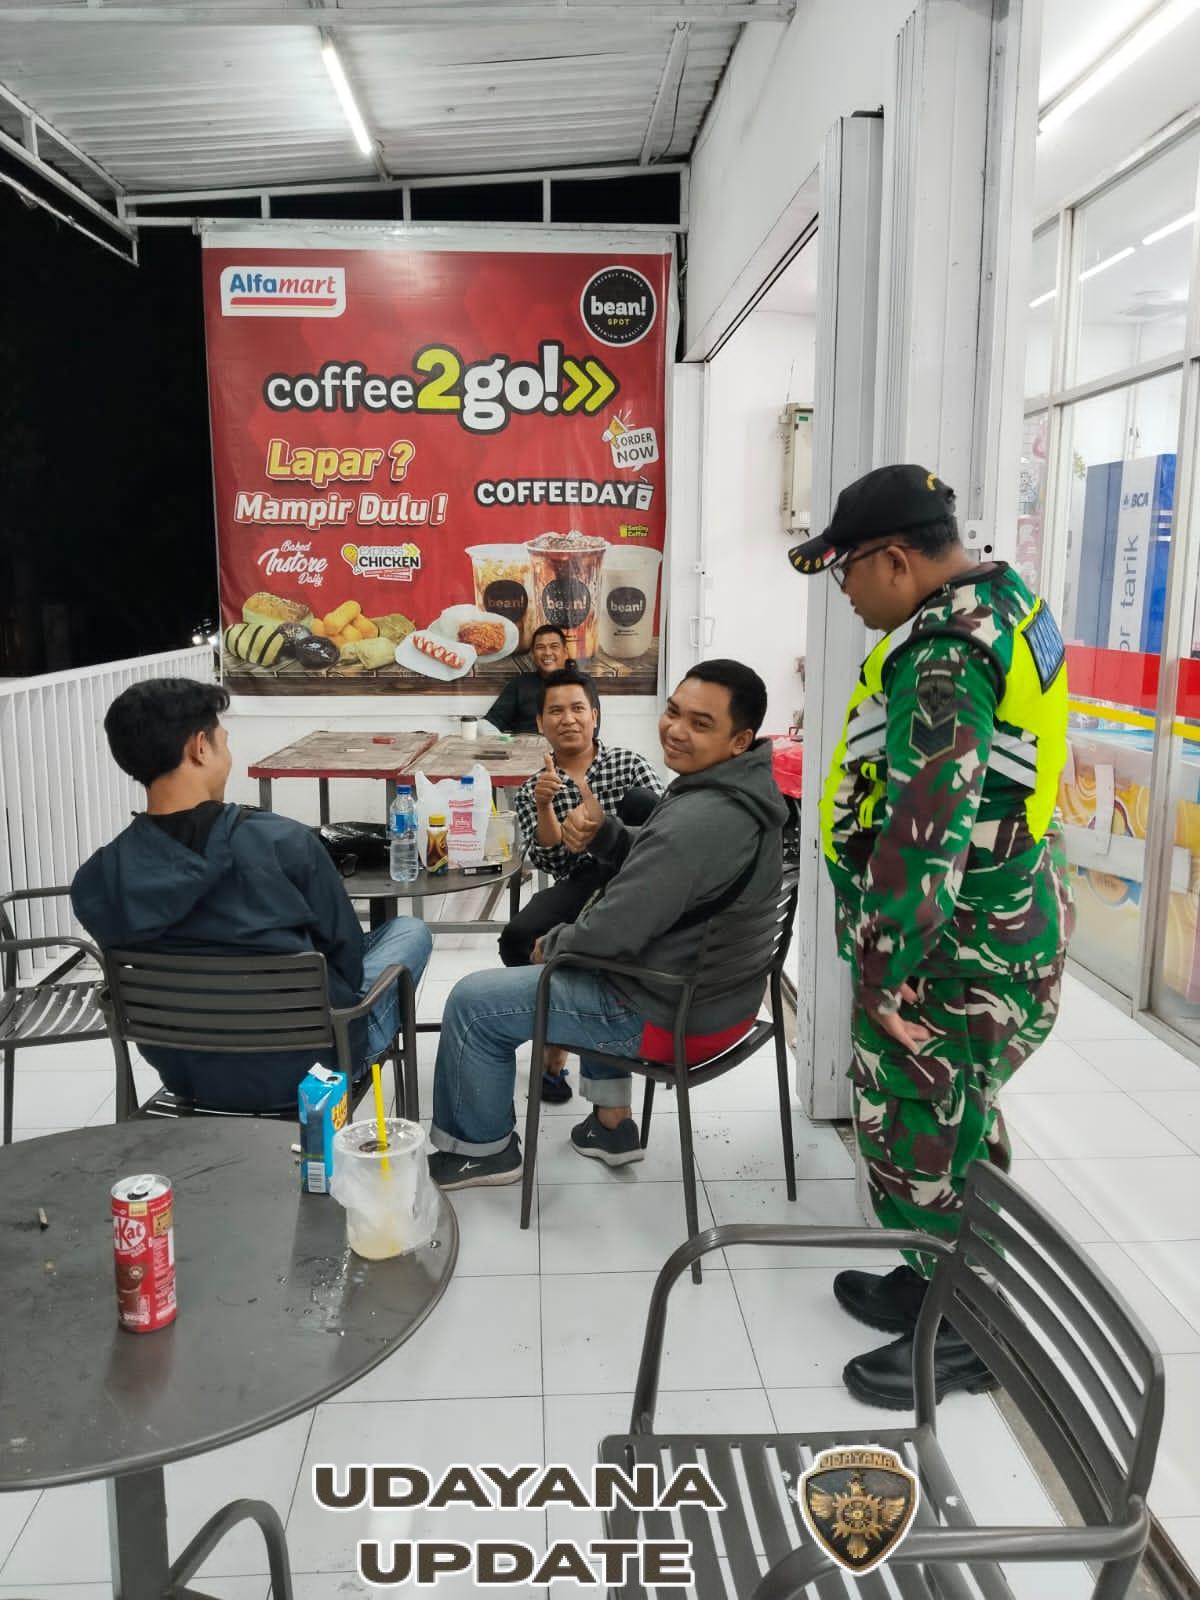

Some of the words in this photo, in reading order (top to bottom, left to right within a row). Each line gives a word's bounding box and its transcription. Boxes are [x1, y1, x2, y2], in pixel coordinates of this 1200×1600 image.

[229, 273, 337, 294] Alfamart
[590, 295, 647, 316] bean!
[607, 318, 631, 326] SPOT
[620, 432, 654, 446] ORDER
[616, 445, 655, 464] NOW
[267, 440, 383, 487] Lapar
[476, 481, 636, 505] COFFEEDAY
[1131, 492, 1149, 508] BCA
[235, 493, 354, 529] Mampir
[358, 493, 429, 525] Dulu
[281, 540, 312, 552] Baked
[257, 548, 328, 576] Instore
[359, 556, 420, 568] CHICKEN
[298, 572, 324, 587] Daily
[1121, 535, 1139, 609] tarik
[487, 595, 524, 609] bean!
[610, 601, 644, 613] bean!
